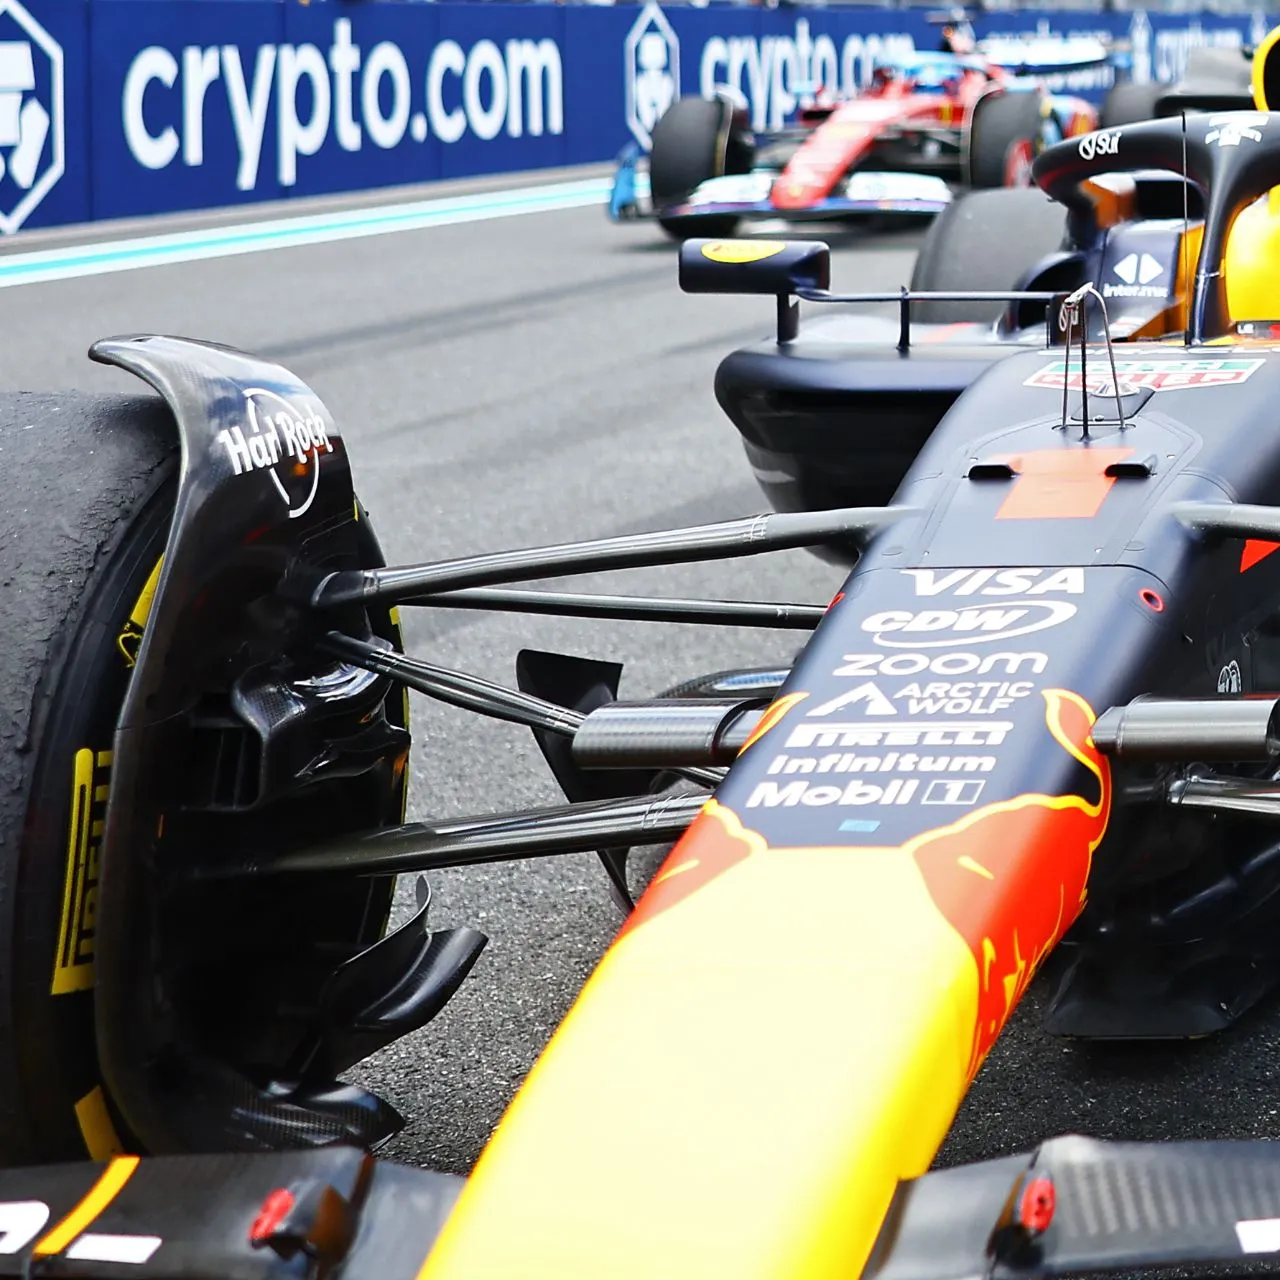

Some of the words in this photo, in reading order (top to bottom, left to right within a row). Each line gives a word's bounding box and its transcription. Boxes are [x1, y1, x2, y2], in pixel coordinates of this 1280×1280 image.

[122, 16, 565, 192] crypto.com
[1094, 130, 1122, 156] Sui
[281, 403, 335, 464] Rock
[900, 567, 1086, 596] VISA
[861, 604, 1045, 638] CDW
[832, 651, 1049, 677] zoom
[893, 681, 1034, 698] ARCTIC
[908, 696, 1015, 715] WOLF
[784, 721, 1015, 749] PIRELLI
[745, 778, 920, 809] Mobil
